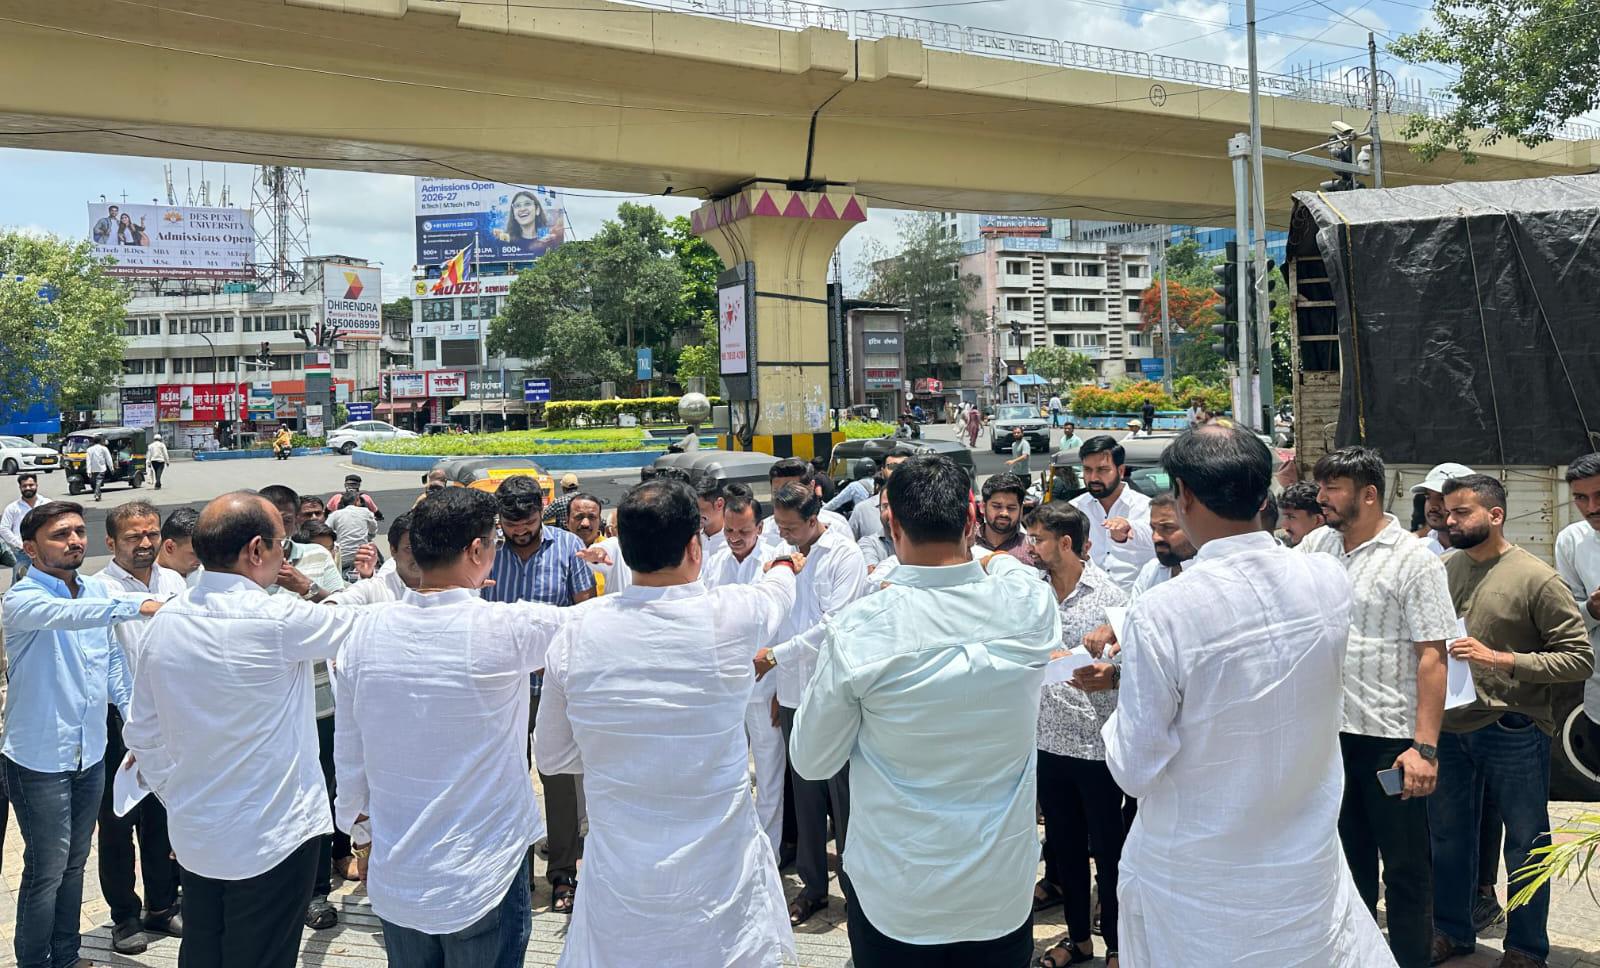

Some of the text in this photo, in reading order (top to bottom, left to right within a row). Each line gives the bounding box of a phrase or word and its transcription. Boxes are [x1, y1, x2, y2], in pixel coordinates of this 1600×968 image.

[1009, 39, 1047, 55] METRO
[421, 182, 495, 193] Admissions Open
[421, 193, 458, 202] 2026-27
[190, 213, 234, 222] DES PUNE
[190, 221, 244, 230] UNIVERSITY
[156, 231, 252, 244] Admissions Open
[327, 299, 378, 312] DHIRENDRA
[326, 318, 380, 329] 9850068999
